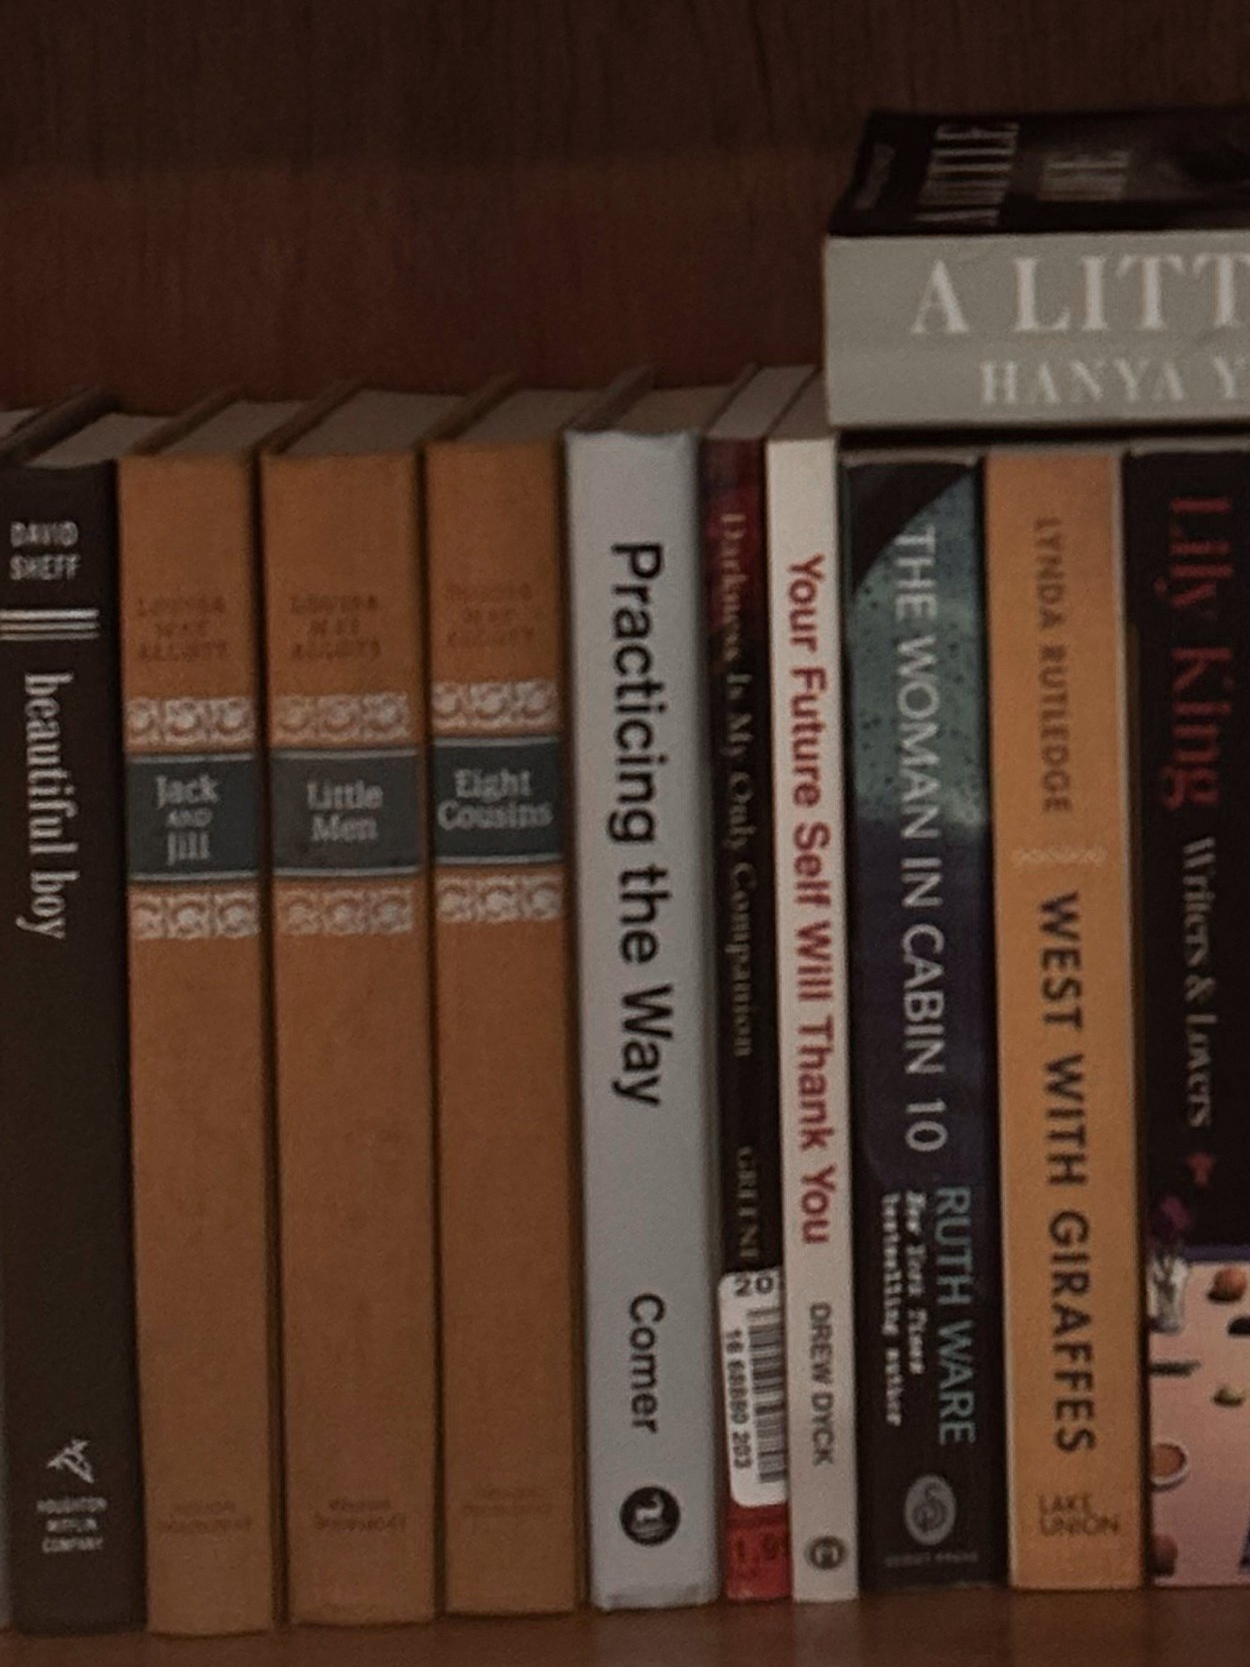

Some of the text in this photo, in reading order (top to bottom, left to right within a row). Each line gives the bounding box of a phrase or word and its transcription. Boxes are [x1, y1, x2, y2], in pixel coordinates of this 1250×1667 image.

[910, 257, 970, 336] A
[978, 356, 1188, 407] HANYA
[1032, 514, 1069, 631] LYNDA
[155, 773, 223, 810] Jack
[306, 779, 386, 813] Little
[454, 767, 532, 803] Eight
[716, 510, 762, 1058] Darkness Is My Only Companion
[1037, 643, 1075, 816] RUTLEDGE
[14, 670, 81, 940] beautiful boy
[311, 814, 380, 843] Men
[436, 801, 555, 833] Cousins
[1154, 496, 1234, 1130] Lily King Writers & Lovers
[607, 540, 682, 1437] Practicing the Way Comer
[785, 551, 840, 1467] Your Future Self Will Thank You DREW DYCK
[892, 522, 979, 1448] THE WOMAN IN CABIN 10 RUTH WARE
[1039, 889, 1086, 1036] WEST
[1042, 1052, 1091, 1189] WITH
[1046, 1208, 1098, 1458] GIRAFFES
